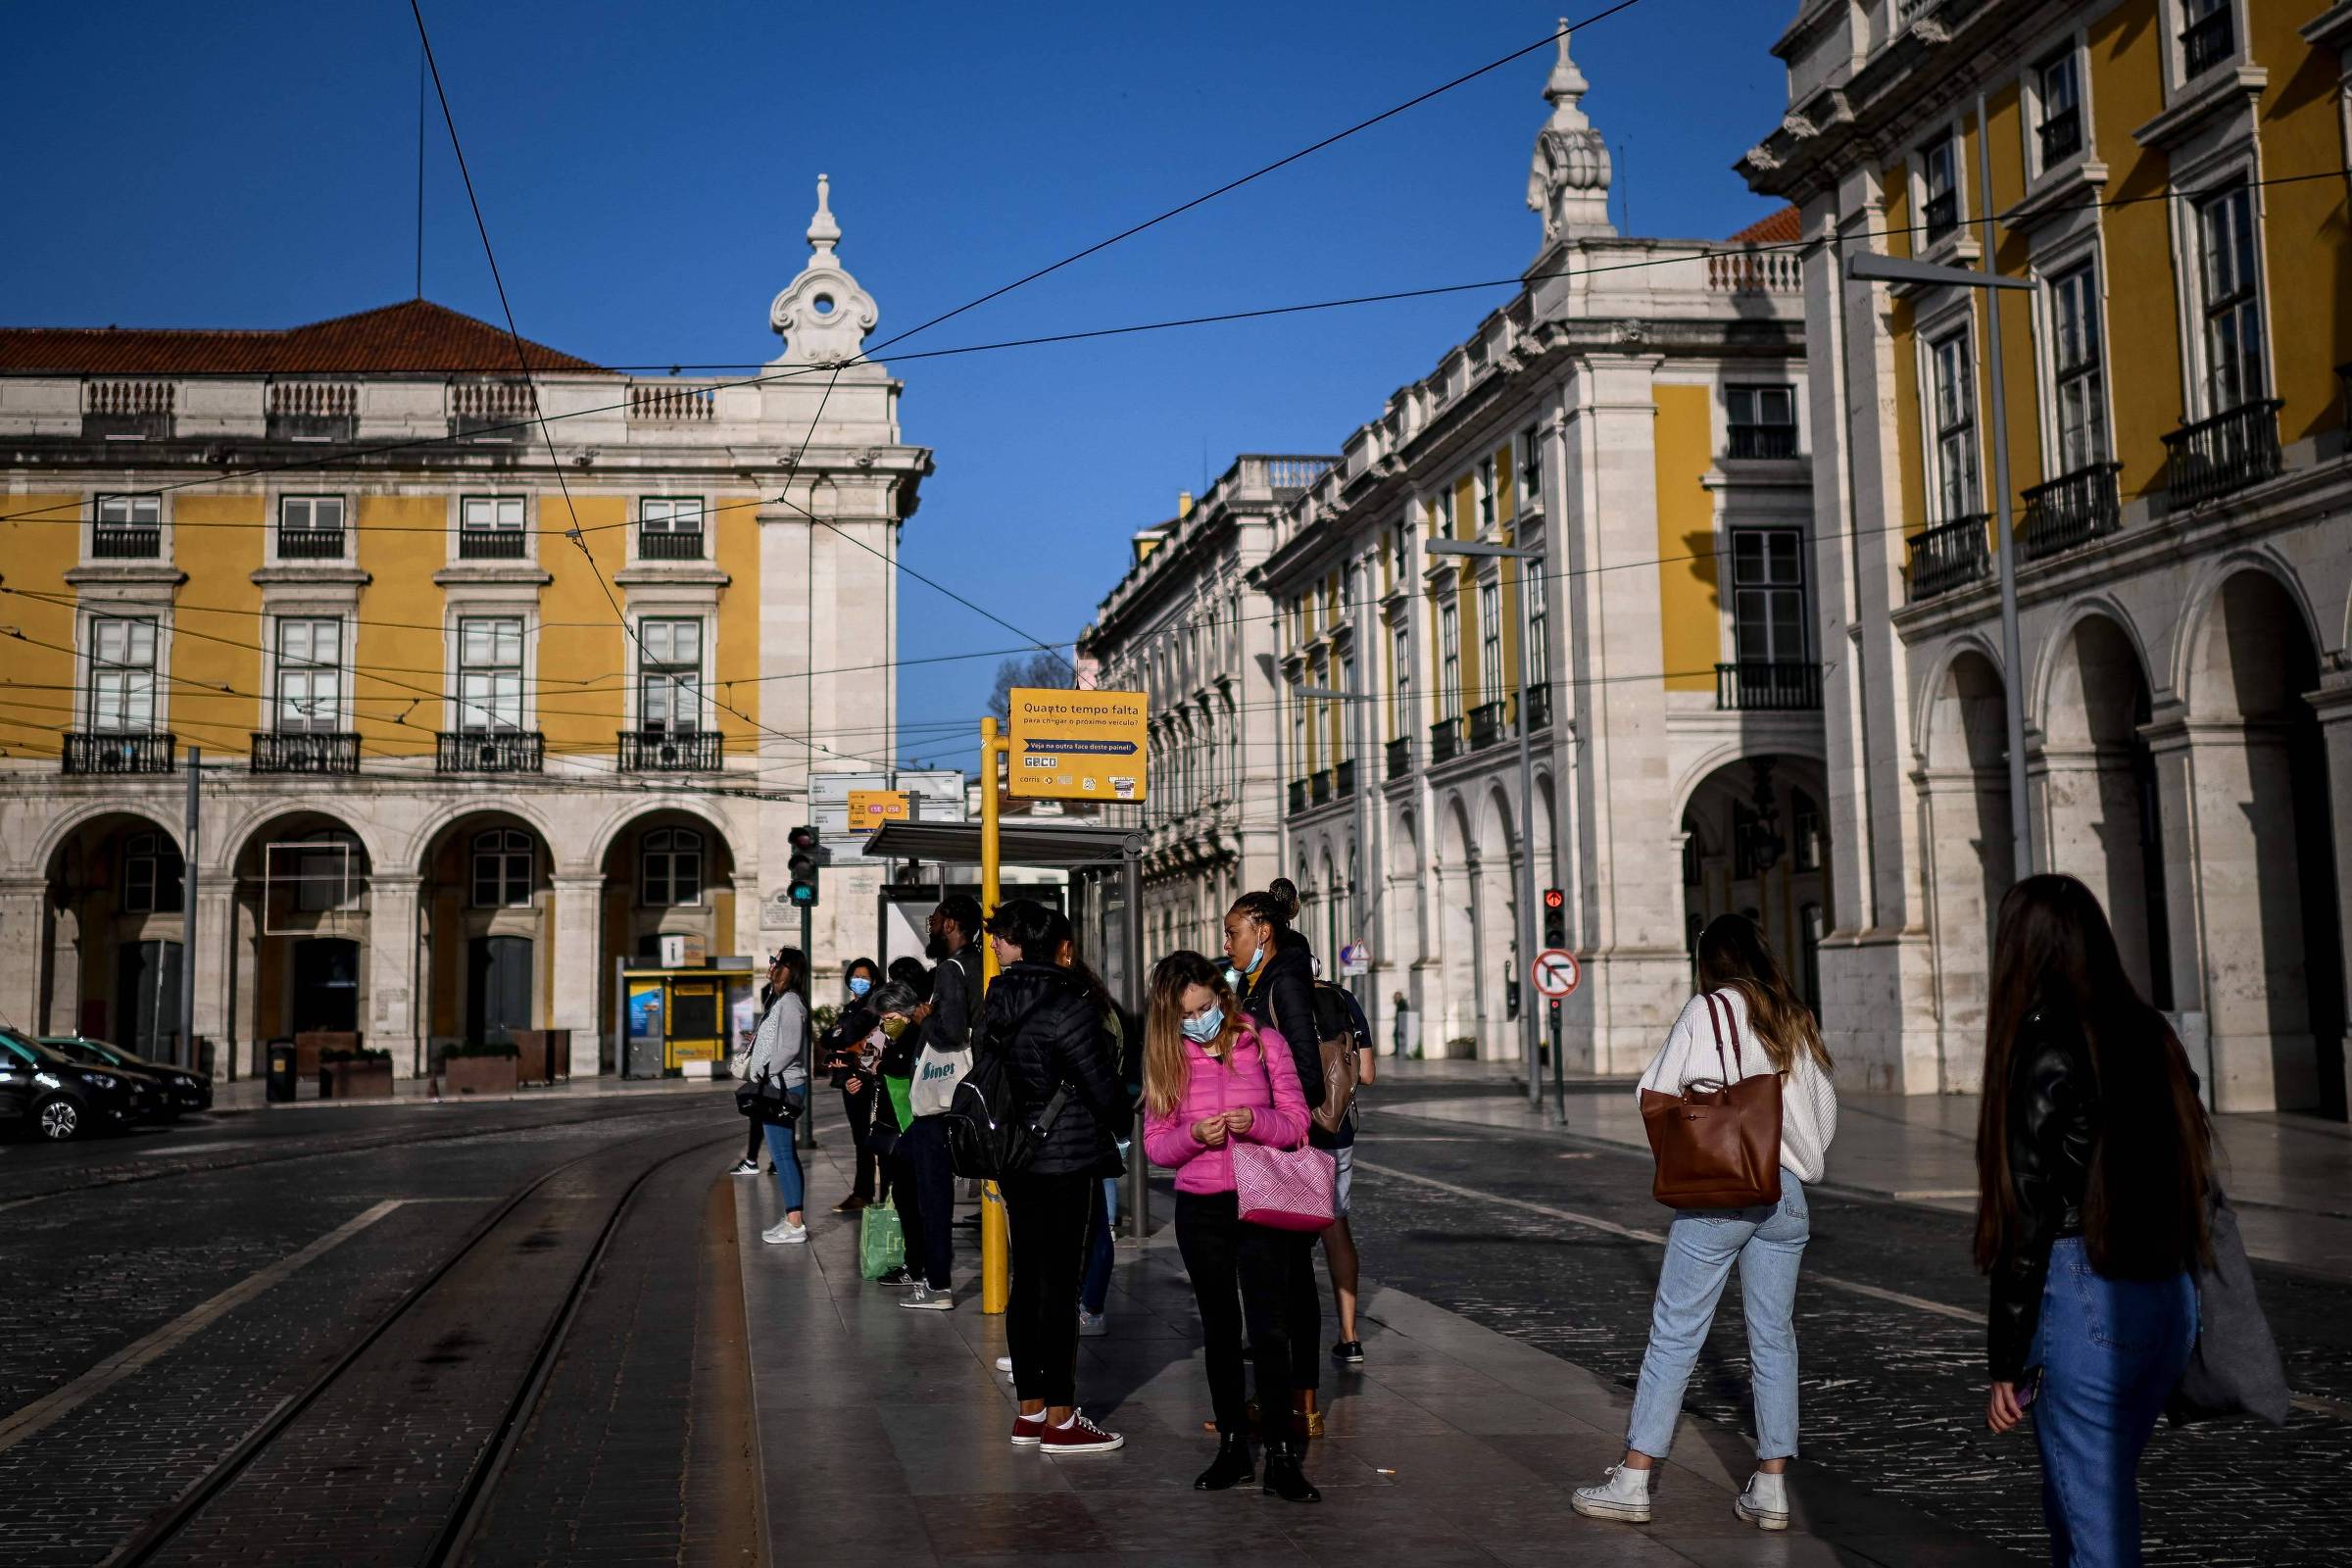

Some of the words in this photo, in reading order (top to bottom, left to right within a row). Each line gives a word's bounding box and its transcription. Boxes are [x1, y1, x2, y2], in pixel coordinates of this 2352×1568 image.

[1024, 703, 1067, 714] Quanto
[1071, 705, 1108, 716] tempo
[1112, 705, 1139, 715] falta
[1030, 742, 1045, 751] Veja
[1108, 744, 1132, 753] painel!
